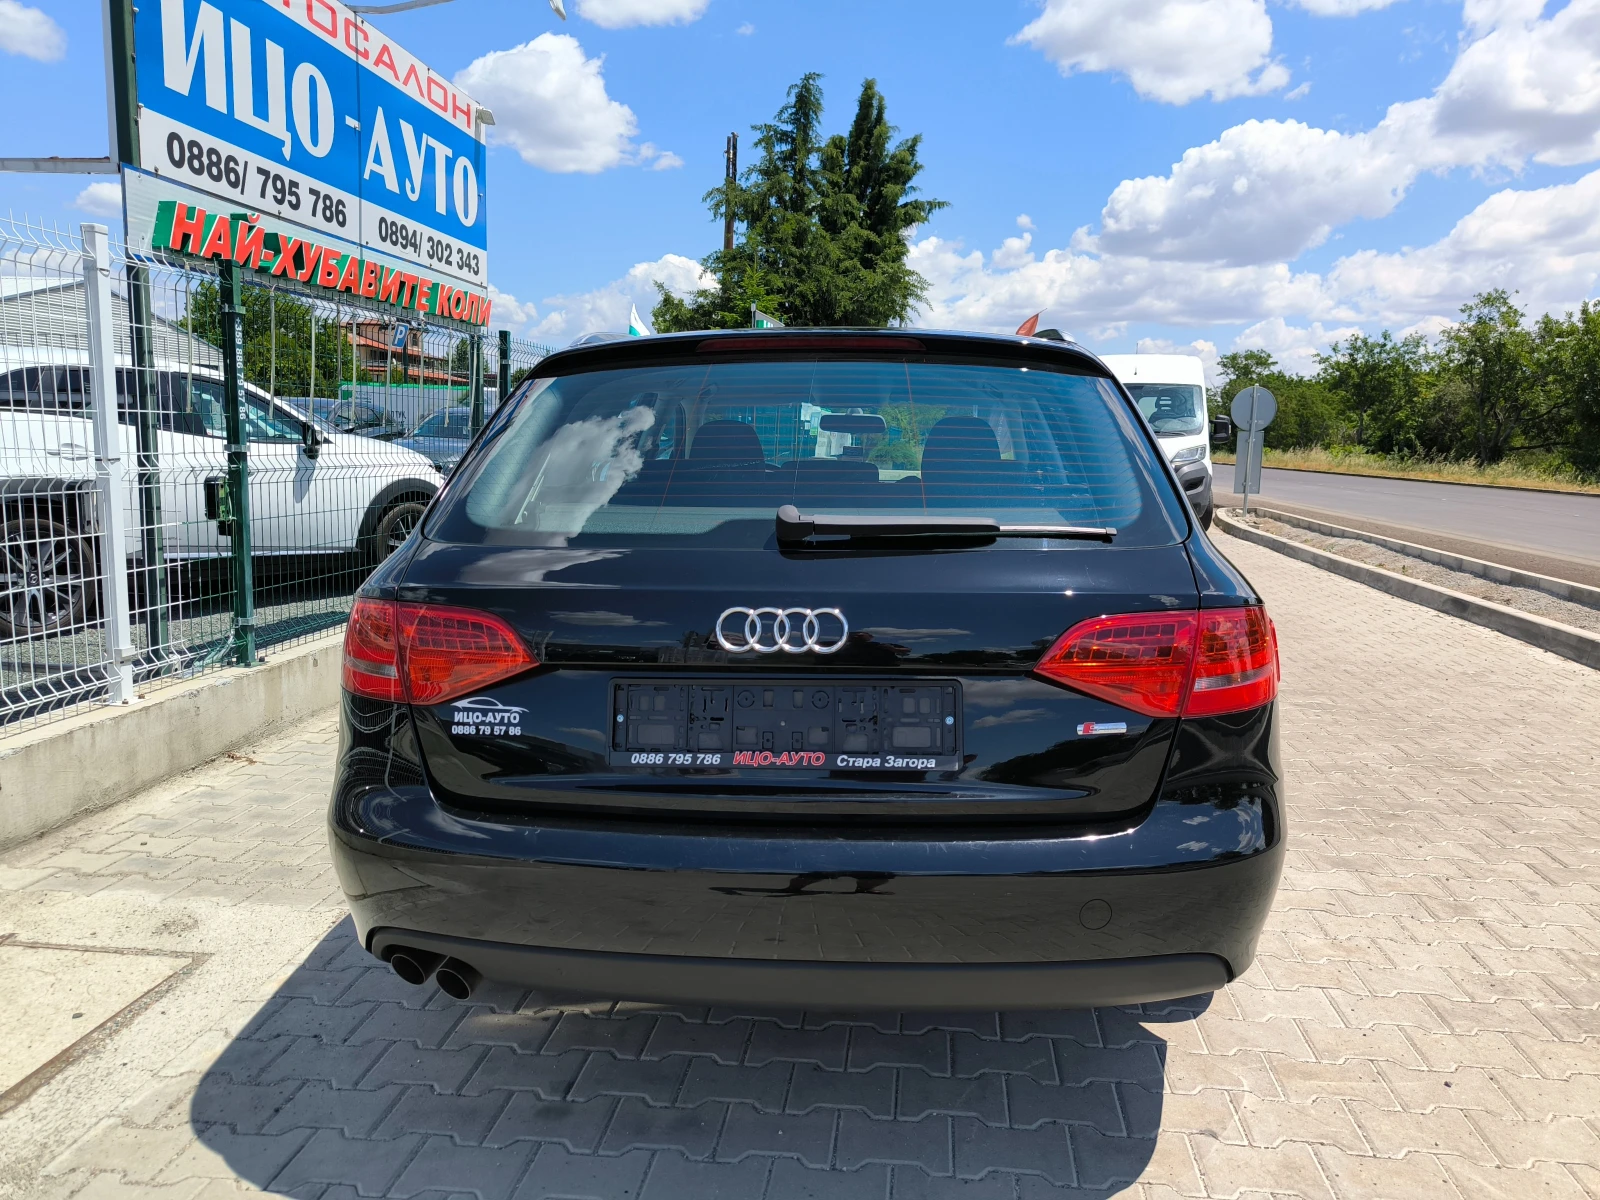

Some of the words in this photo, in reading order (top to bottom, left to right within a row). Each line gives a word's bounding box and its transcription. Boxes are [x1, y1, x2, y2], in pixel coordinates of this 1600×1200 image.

[282, 0, 471, 129] ОСАЛОН
[167, 132, 248, 195] 0886/
[256, 166, 300, 211] 795
[308, 187, 347, 228] 786
[378, 216, 422, 257] 0894/
[427, 236, 452, 266] 302
[457, 248, 480, 276] 343
[169, 200, 432, 312] НАЙ-ХУБАВИТЕ
[436, 282, 492, 327] КОЛИ
[235, 348, 243, 369] 886
[236, 372, 244, 386] 79
[238, 389, 245, 403] 57
[239, 406, 246, 420] 86
[454, 711, 520, 725] ИЦО-АУТО
[451, 725, 476, 735] 0886
[479, 726, 491, 735] 79
[493, 726, 506, 736] 57
[508, 726, 522, 736] 86
[630, 753, 663, 765] 0886
[667, 753, 692, 765] 795
[696, 754, 721, 766] 786
[733, 751, 825, 767] ИЦО-АУТО
[836, 755, 880, 768] Стара
[884, 756, 936, 769] Загора
